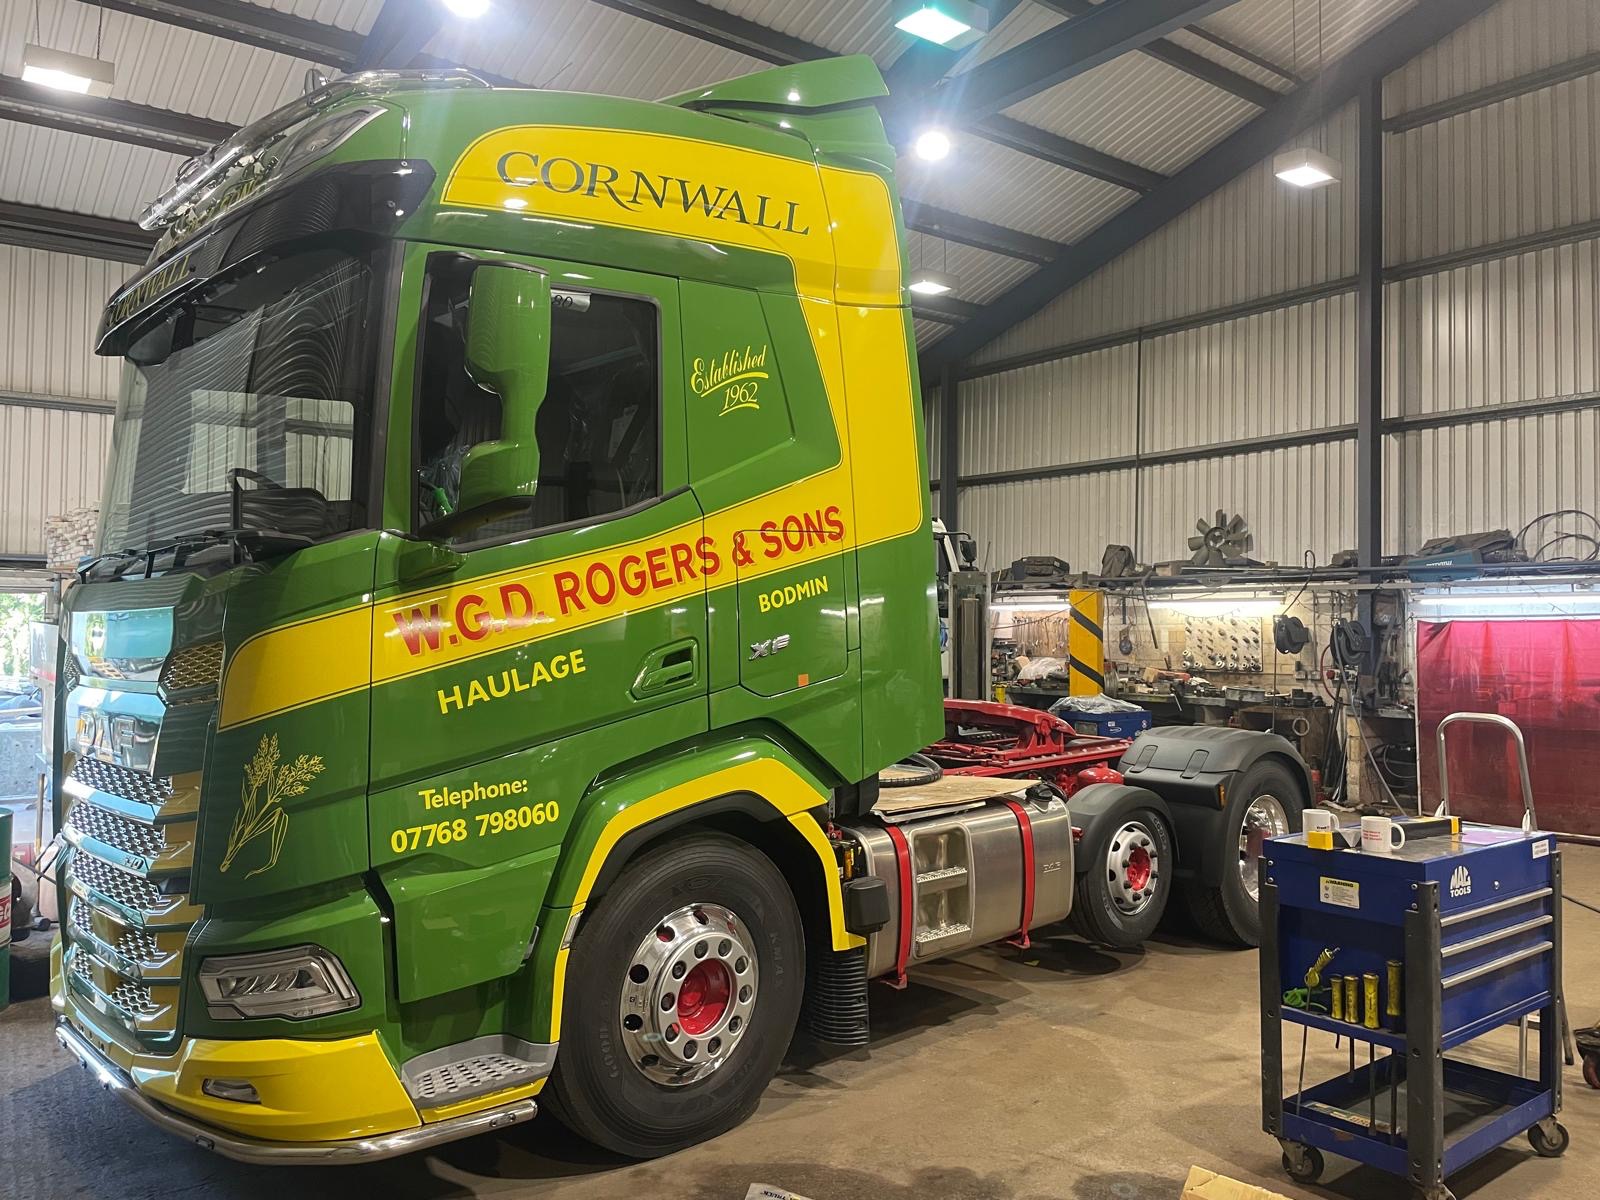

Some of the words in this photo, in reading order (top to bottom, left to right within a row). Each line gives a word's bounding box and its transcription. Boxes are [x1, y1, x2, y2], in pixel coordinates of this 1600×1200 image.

[497, 151, 810, 236] CORNWALL
[690, 344, 768, 394] Established
[722, 381, 759, 411] 1962
[392, 582, 547, 657] W.G.D.
[553, 535, 722, 616] ROGERS
[733, 530, 755, 567] &
[760, 505, 847, 557] SONS
[758, 575, 829, 613] BODMIN
[436, 648, 587, 714] HAULAGE
[418, 779, 529, 810] Telephone:
[390, 818, 468, 853] 07768
[475, 800, 560, 837] 798060
[1450, 885, 1472, 898] TOOLS
